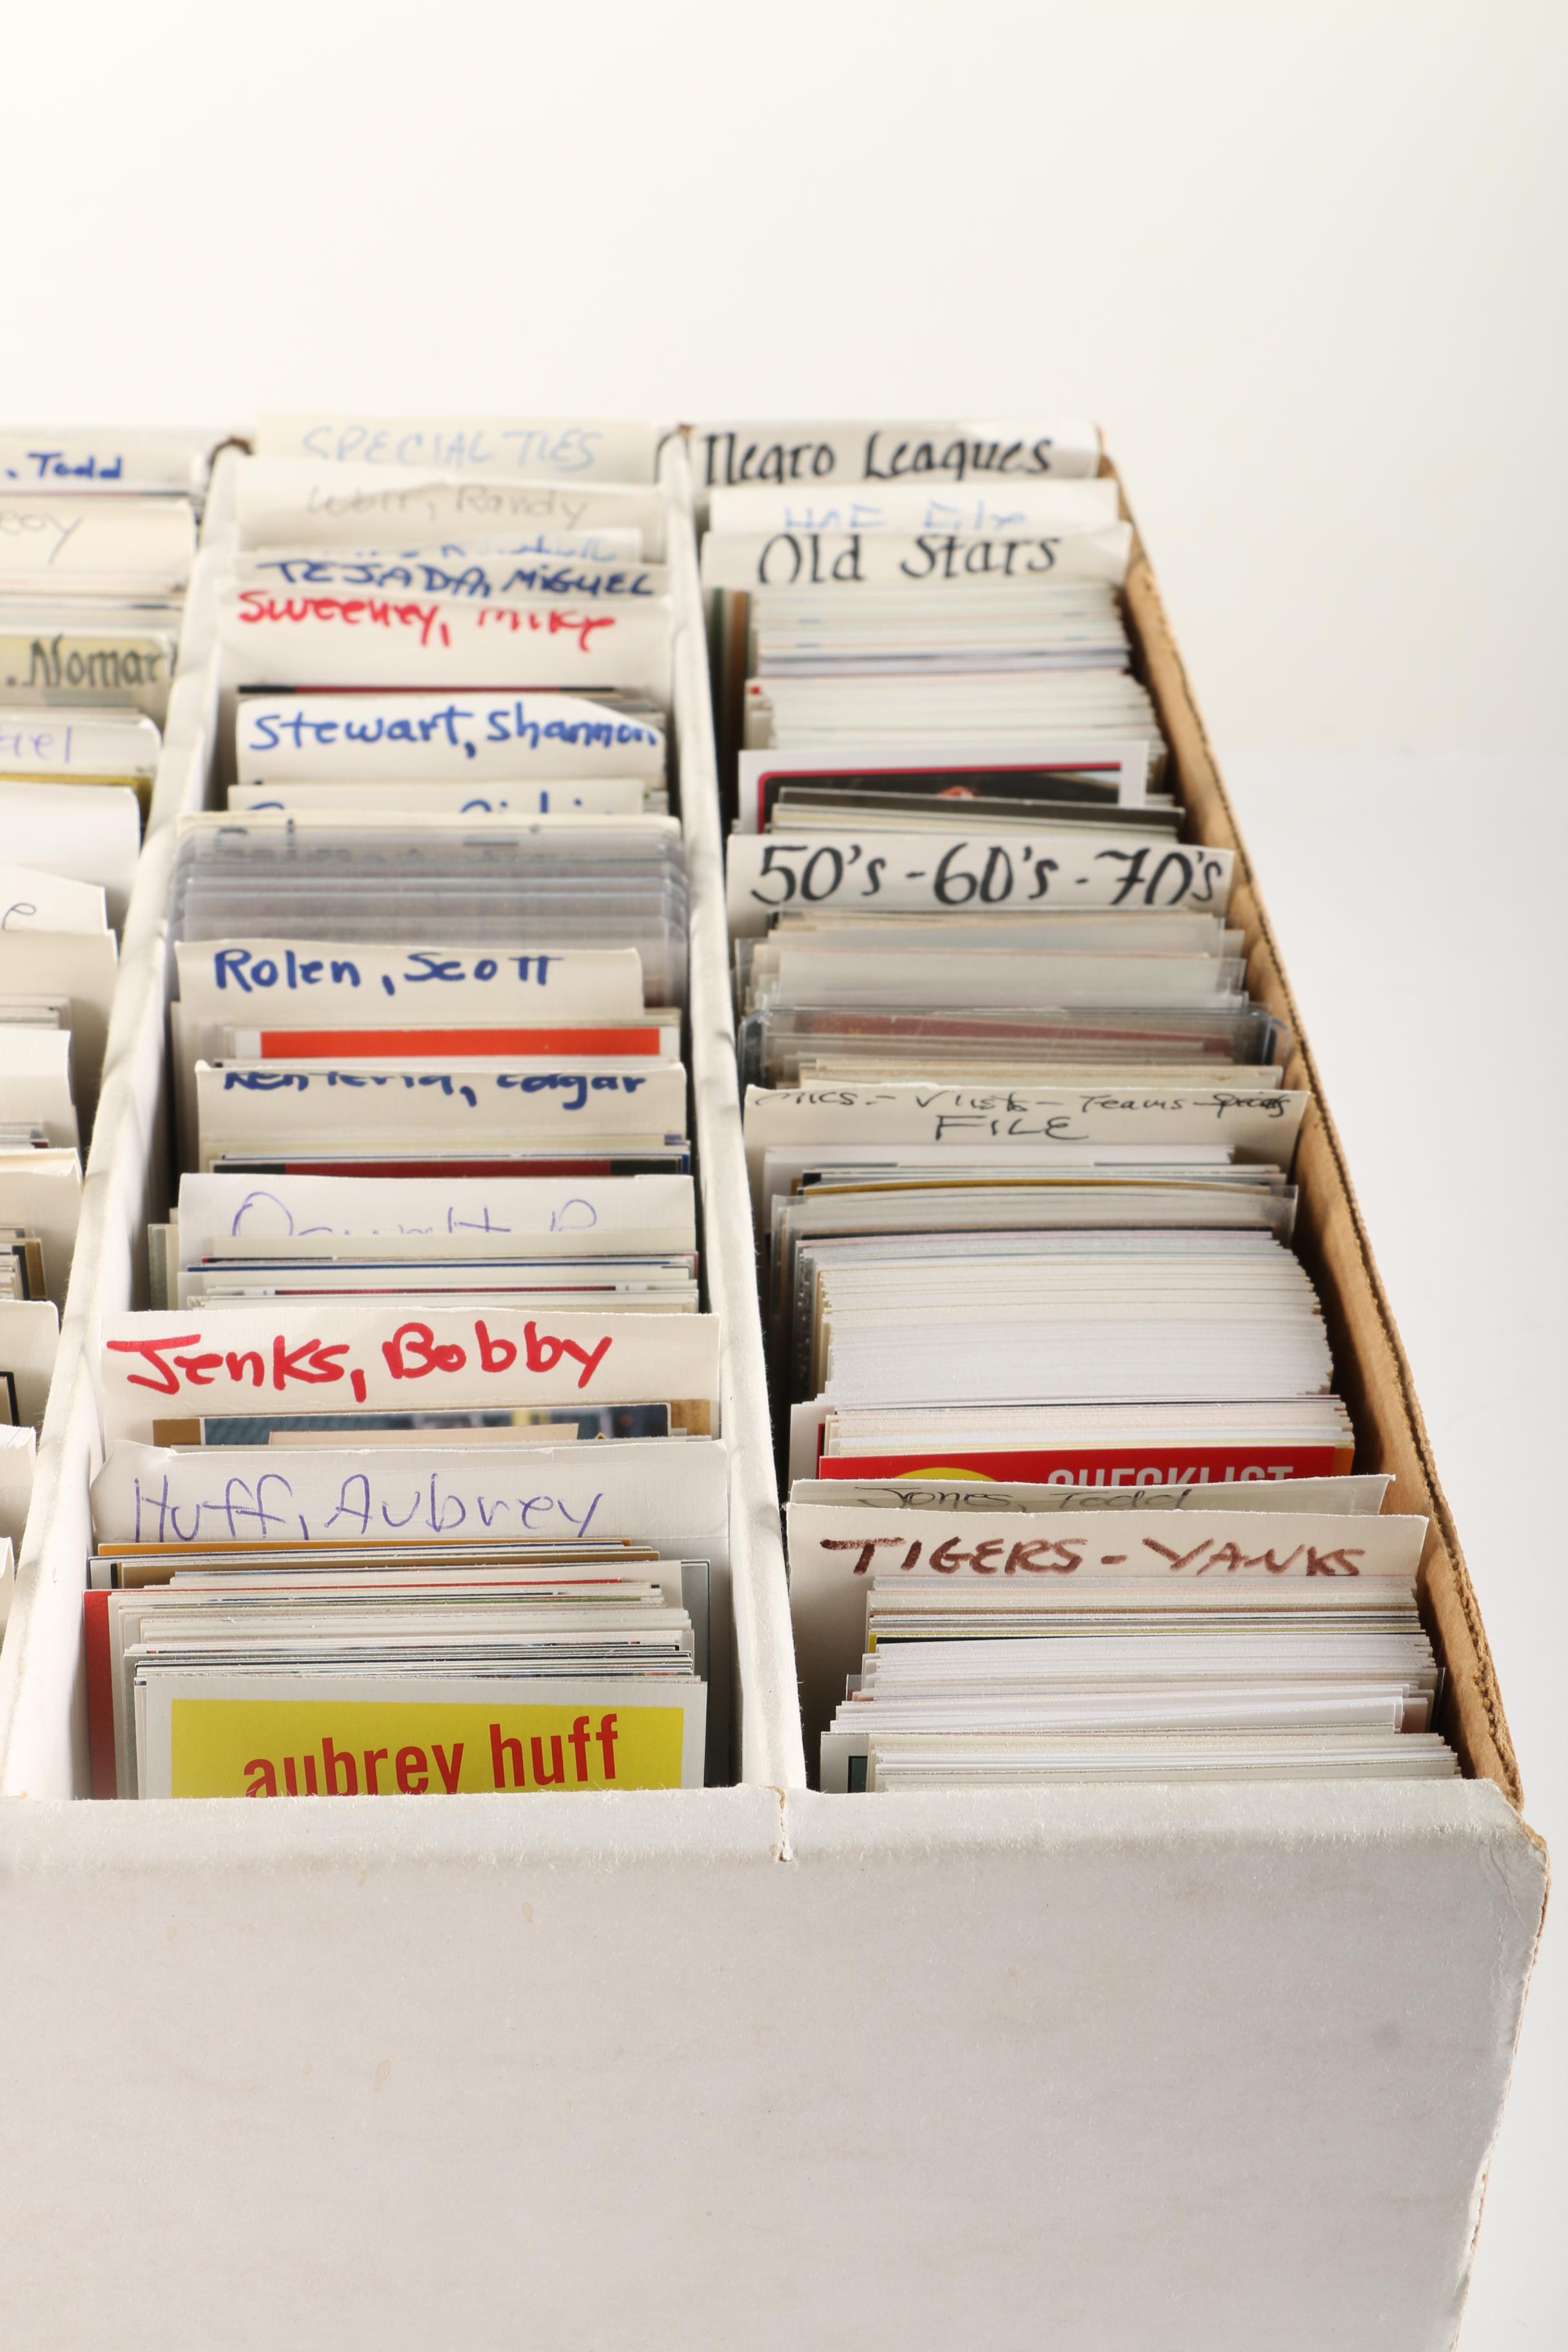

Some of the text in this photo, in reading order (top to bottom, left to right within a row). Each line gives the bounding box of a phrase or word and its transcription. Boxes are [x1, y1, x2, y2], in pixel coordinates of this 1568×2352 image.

[26, 451, 123, 480] Todd
[701, 431, 836, 486] Negro
[757, 533, 1063, 583] Old Stars
[249, 700, 658, 760] Stewart, Shannon
[750, 844, 887, 904] 50's
[213, 948, 565, 997] Rolen, Scott
[934, 1114, 1088, 1142] FILE
[106, 1320, 613, 1404] Jenks, Bobby
[134, 1473, 604, 1542] Huff, Aubrey
[819, 1536, 1088, 1577] TIGERS
[1142, 1536, 1366, 1577] YANKS
[243, 1713, 619, 1798] aubrey huff
